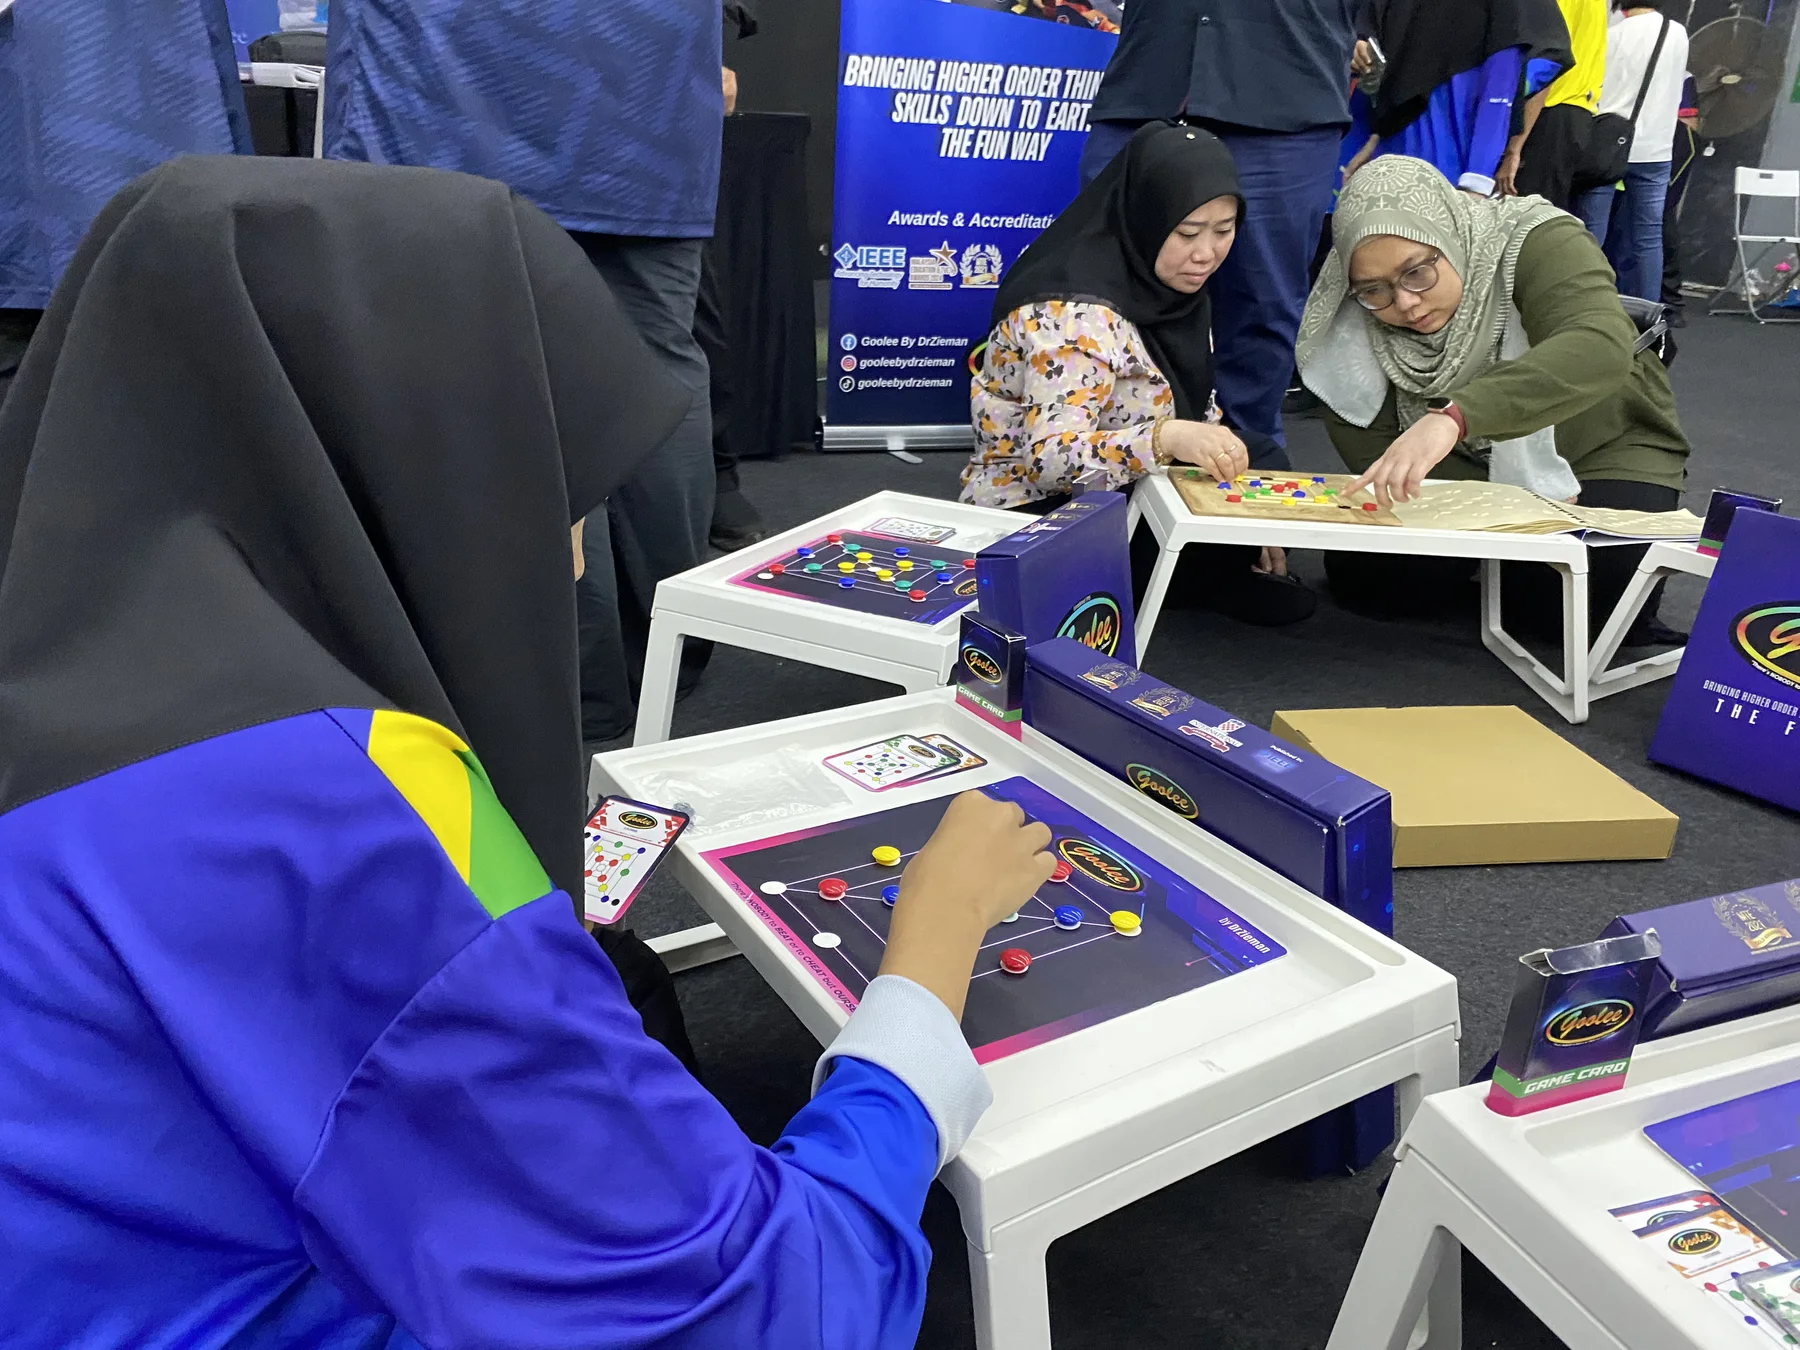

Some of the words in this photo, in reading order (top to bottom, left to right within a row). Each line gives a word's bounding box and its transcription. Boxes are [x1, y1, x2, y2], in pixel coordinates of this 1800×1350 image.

[843, 55, 937, 91] BRINGING
[936, 61, 1004, 95] HIGHER
[1003, 66, 1062, 98] ORDER
[1063, 69, 1105, 100] THIN
[892, 92, 951, 125] SKILLS
[956, 96, 1015, 128] DOWN
[1020, 100, 1043, 129] TO
[1045, 101, 1092, 132] EART
[940, 128, 973, 158] THE
[974, 130, 1010, 160] FUN
[1010, 132, 1053, 161] WAY
[888, 210, 948, 226] Awards
[952, 212, 965, 227] &
[968, 212, 1056, 229] Accreditati
[858, 248, 906, 267] IEEE
[861, 337, 898, 347] Goolee
[901, 337, 916, 348] By
[917, 336, 968, 347] DrZieman
[859, 357, 955, 370] gooleebydrzieman
[857, 377, 953, 390] gooleebydrzieman
[970, 652, 997, 676] Goolee
[958, 686, 980, 703] GAME
[981, 700, 1004, 718] CARD
[1703, 680, 1741, 699] BRINGING
[1741, 692, 1771, 708] HIGHER
[1771, 701, 1799, 717] ORDER
[1715, 698, 1760, 725] THE
[1137, 770, 1188, 808] Goolee
[1067, 847, 1130, 884] Goolee
[1218, 916, 1233, 926] by
[1228, 924, 1271, 953] DrZieman
[775, 927, 794, 941] BEAT
[796, 948, 804, 956] to
[803, 955, 826, 976] CHEAT
[823, 977, 836, 989] but
[834, 989, 858, 1012] OURSE
[1560, 1006, 1623, 1039] Goolee
[1524, 1072, 1576, 1094] GAME
[1577, 1061, 1627, 1080] CARD
